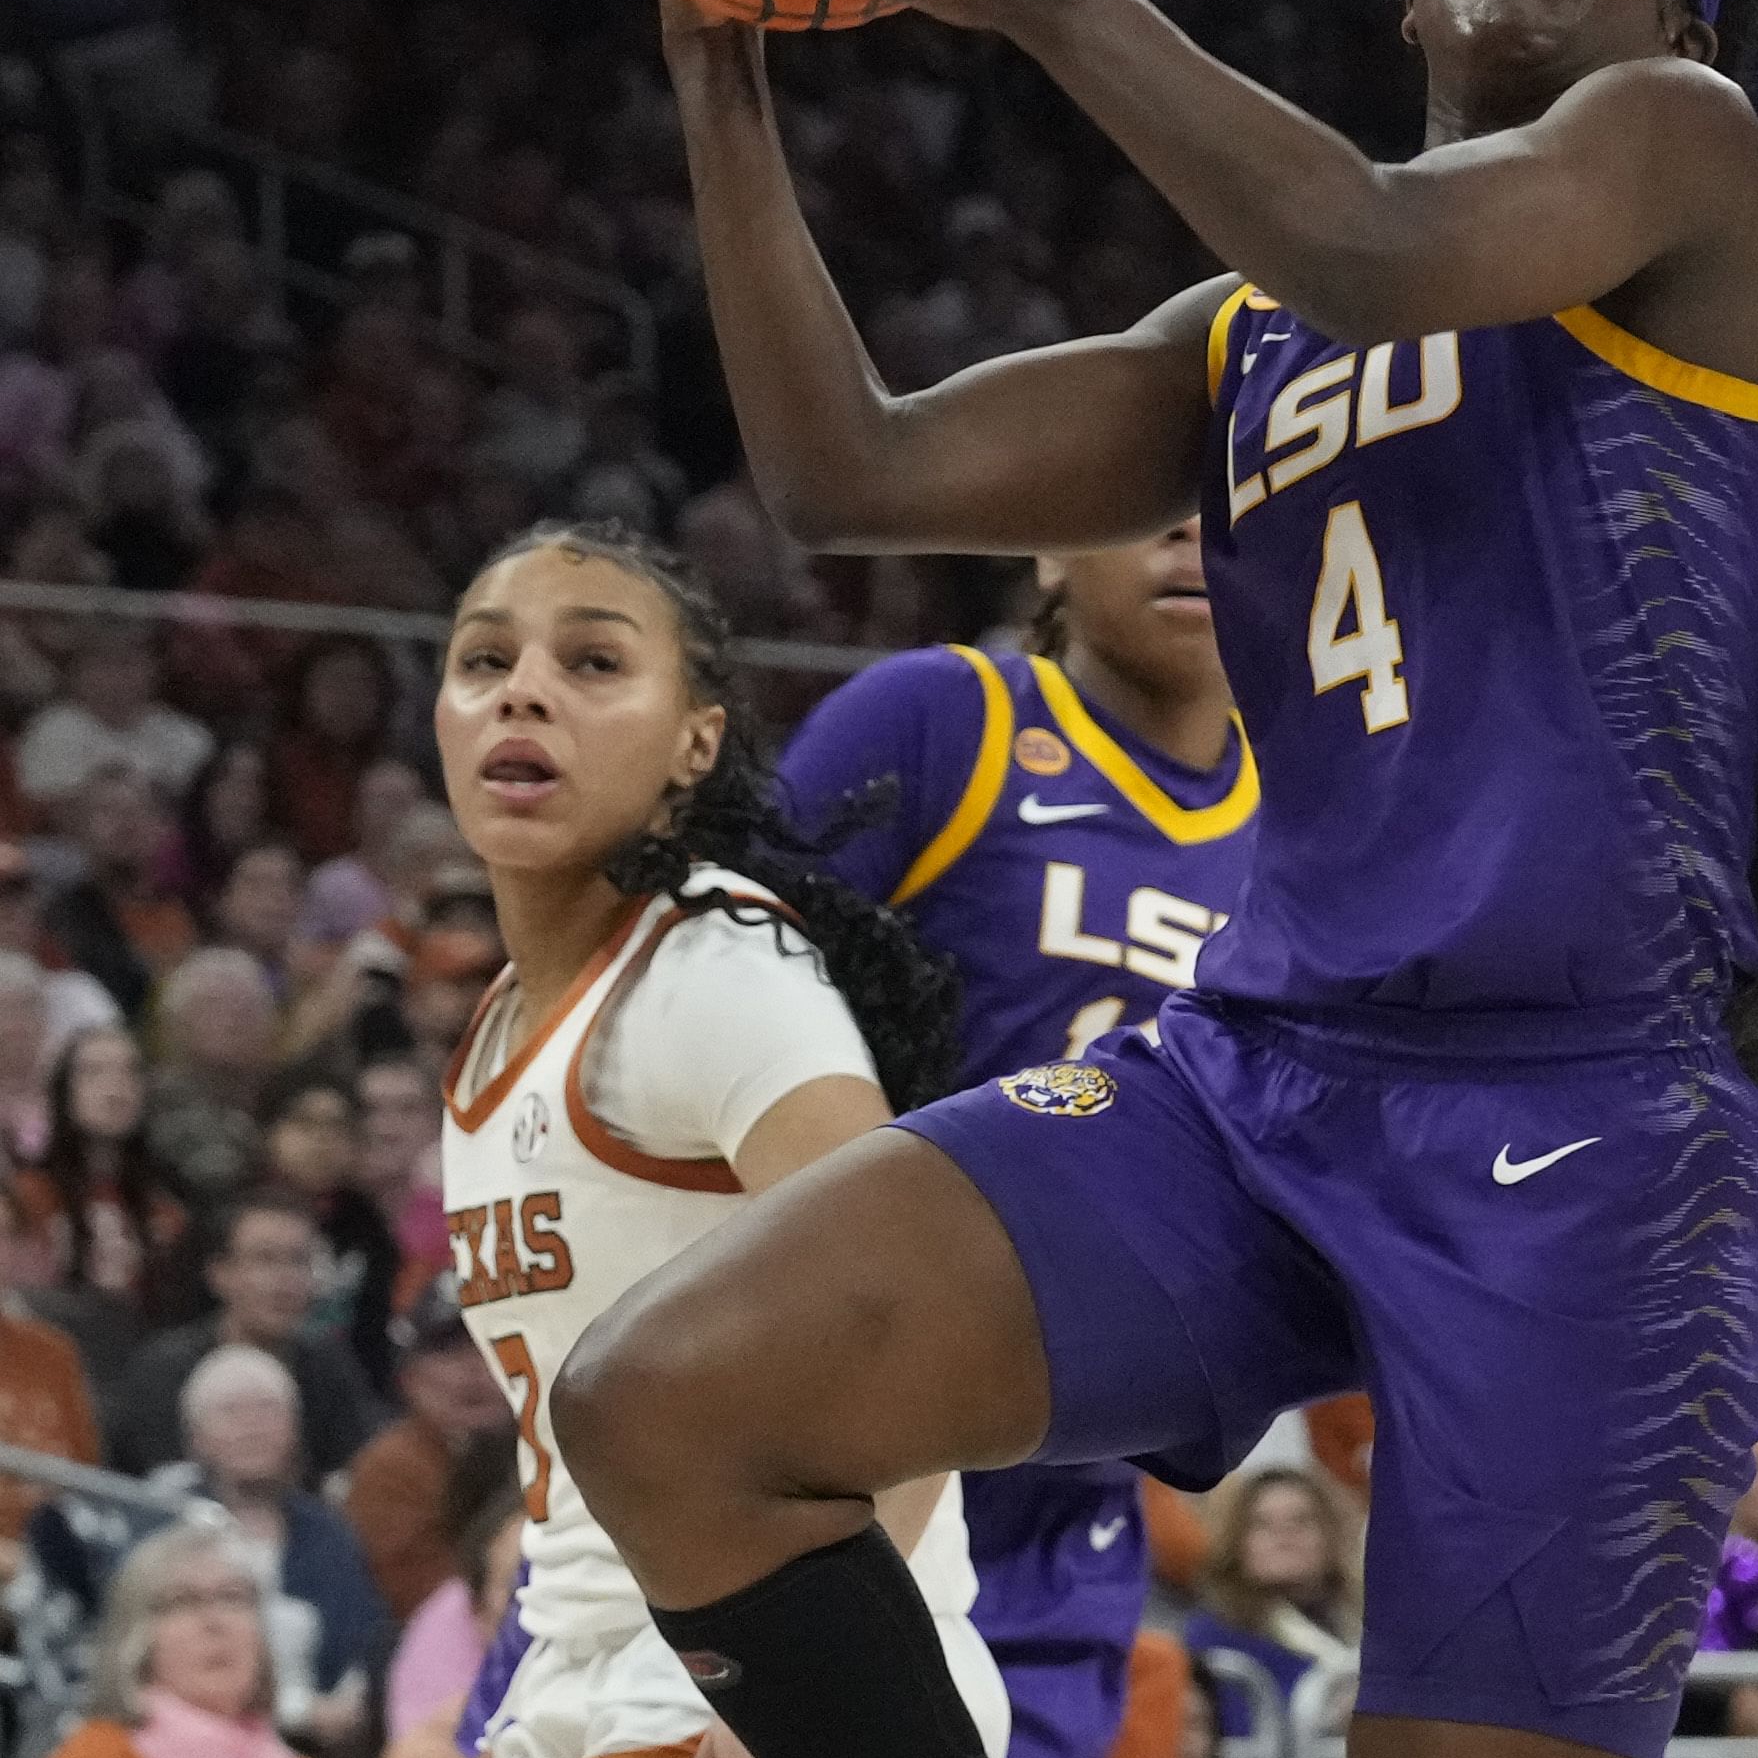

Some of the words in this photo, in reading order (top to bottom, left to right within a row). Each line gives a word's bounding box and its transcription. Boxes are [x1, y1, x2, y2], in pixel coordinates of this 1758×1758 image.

[1226, 329, 1463, 531] LSU
[1307, 499, 1410, 736] 4
[1038, 860, 1230, 990] LS
[446, 1190, 574, 1308] XAS
